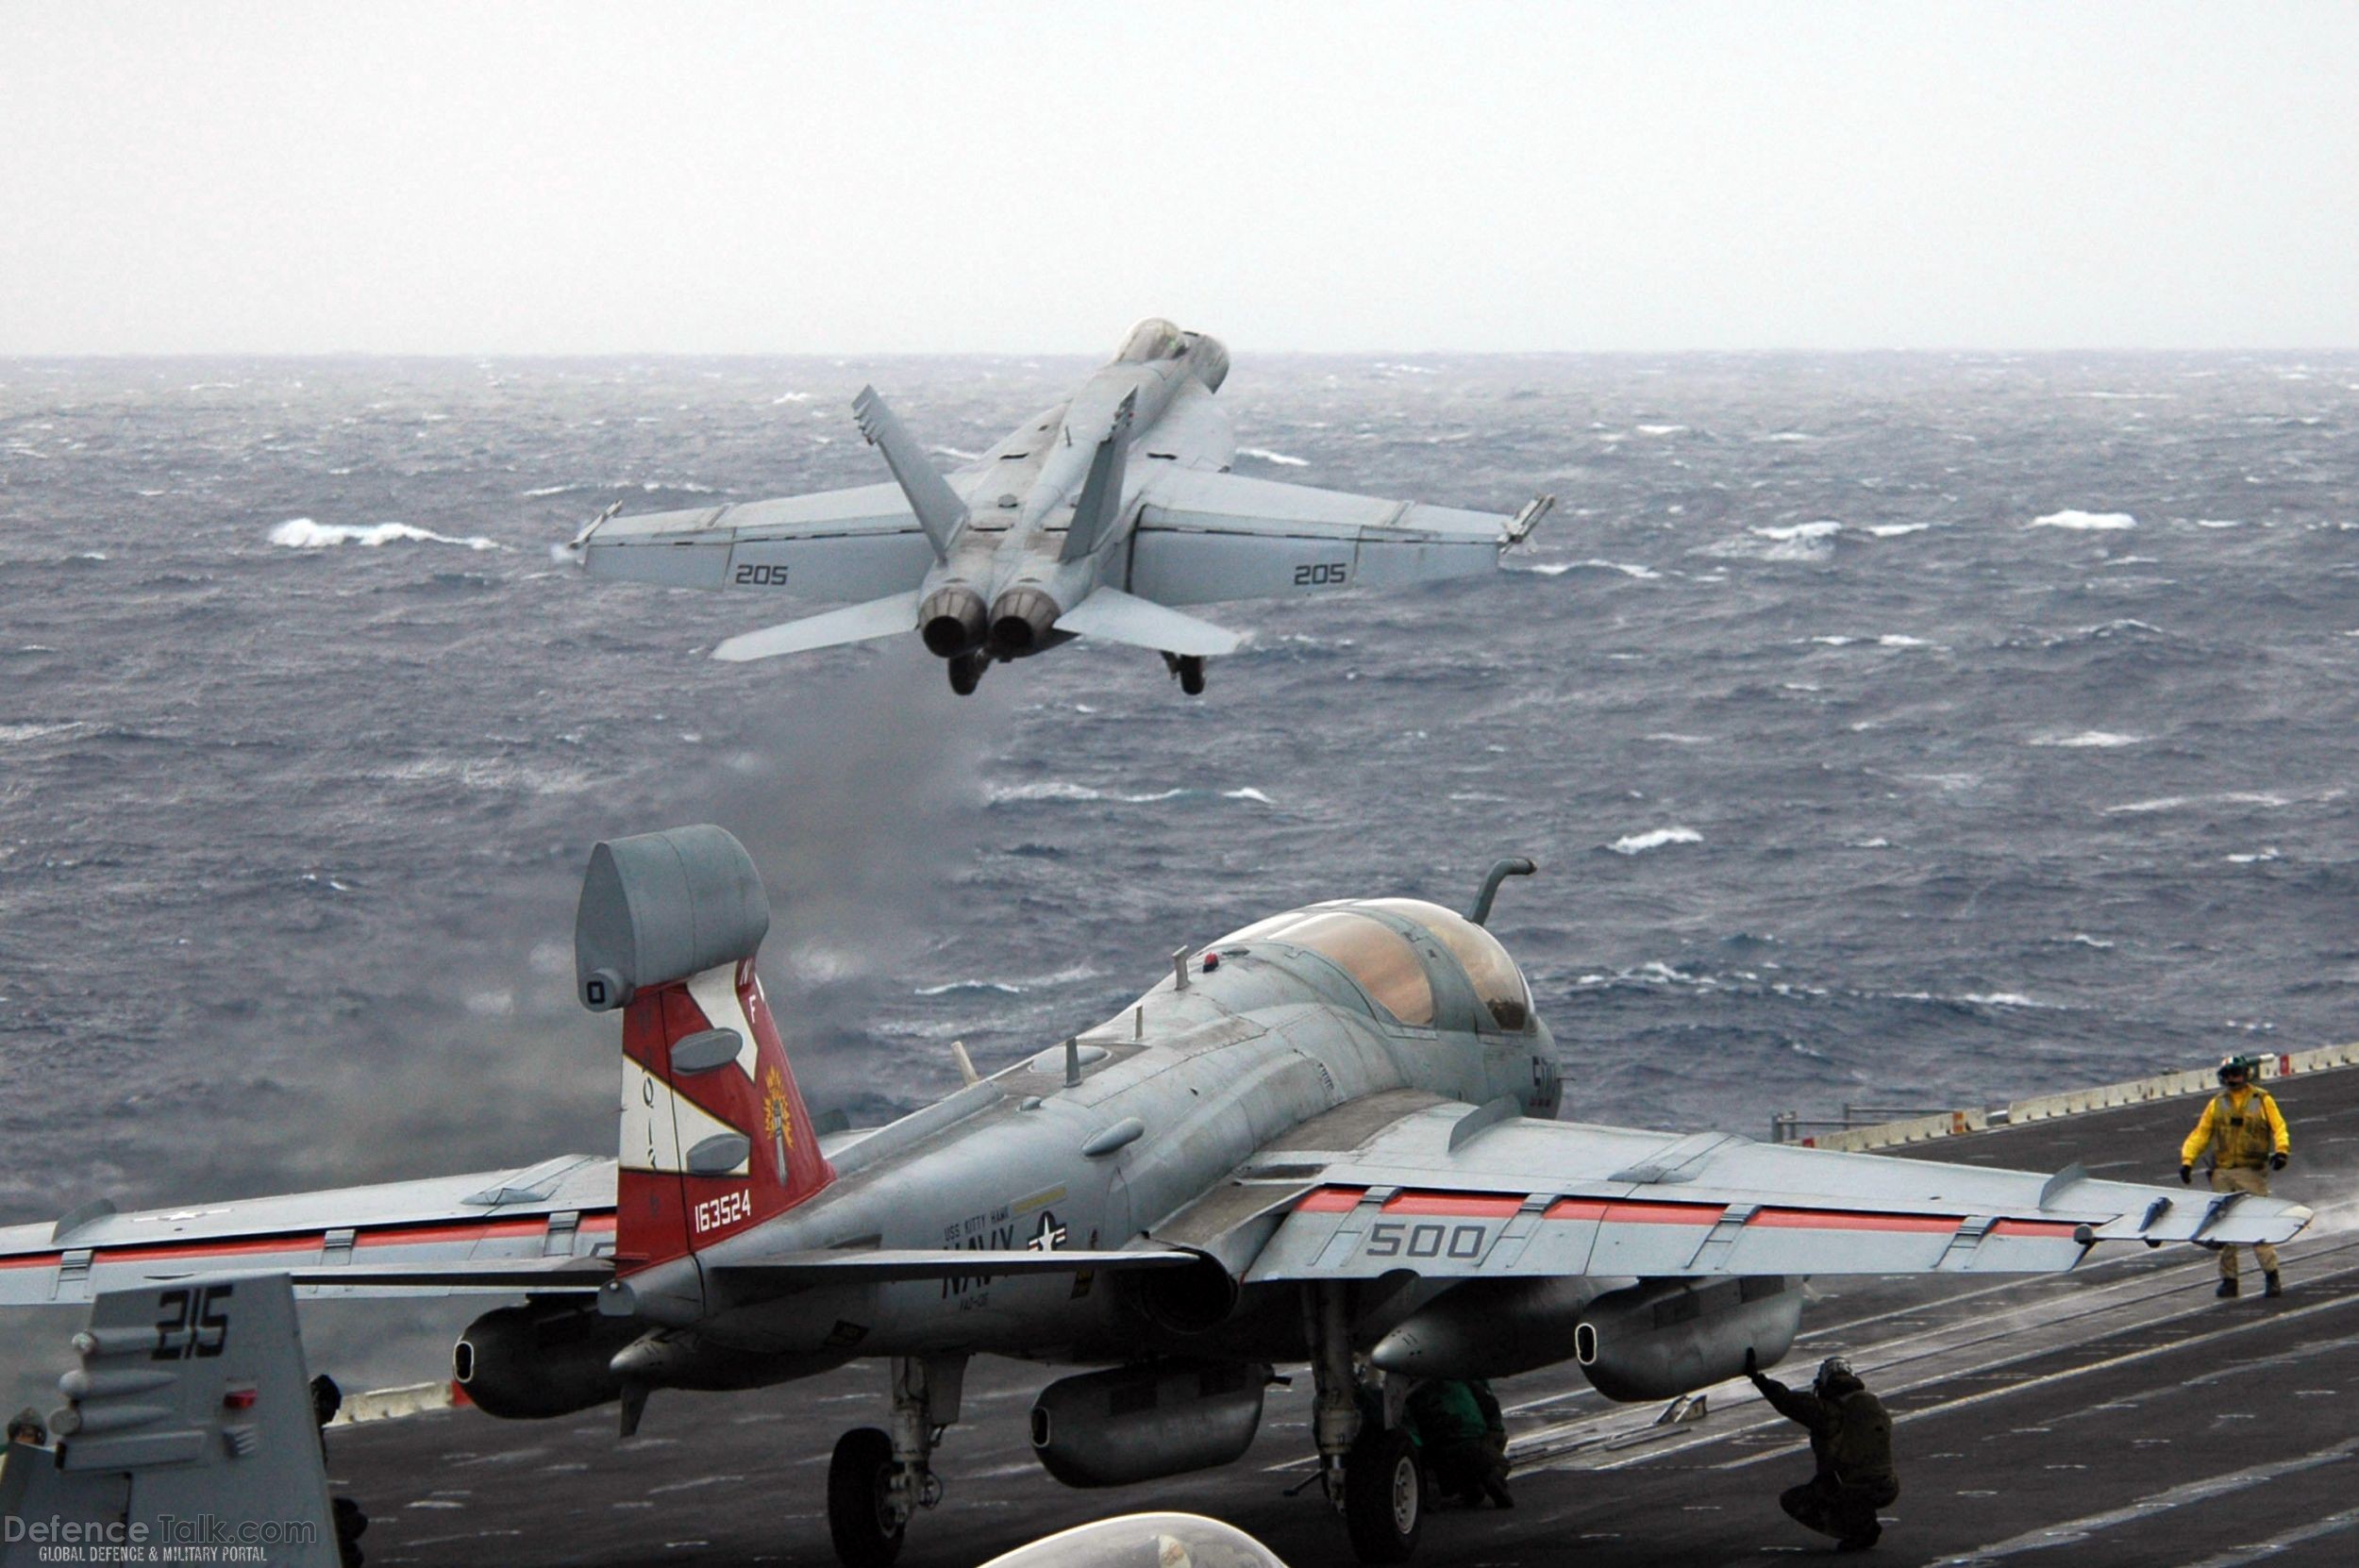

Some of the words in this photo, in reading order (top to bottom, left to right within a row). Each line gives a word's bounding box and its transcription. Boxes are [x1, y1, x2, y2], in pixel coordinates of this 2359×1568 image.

[736, 564, 789, 585] 205
[1295, 563, 1347, 585] 205
[694, 1189, 751, 1233] 163524
[945, 1223, 960, 1242] USS
[1366, 1224, 1486, 1258] 500
[151, 1284, 233, 1359] 215
